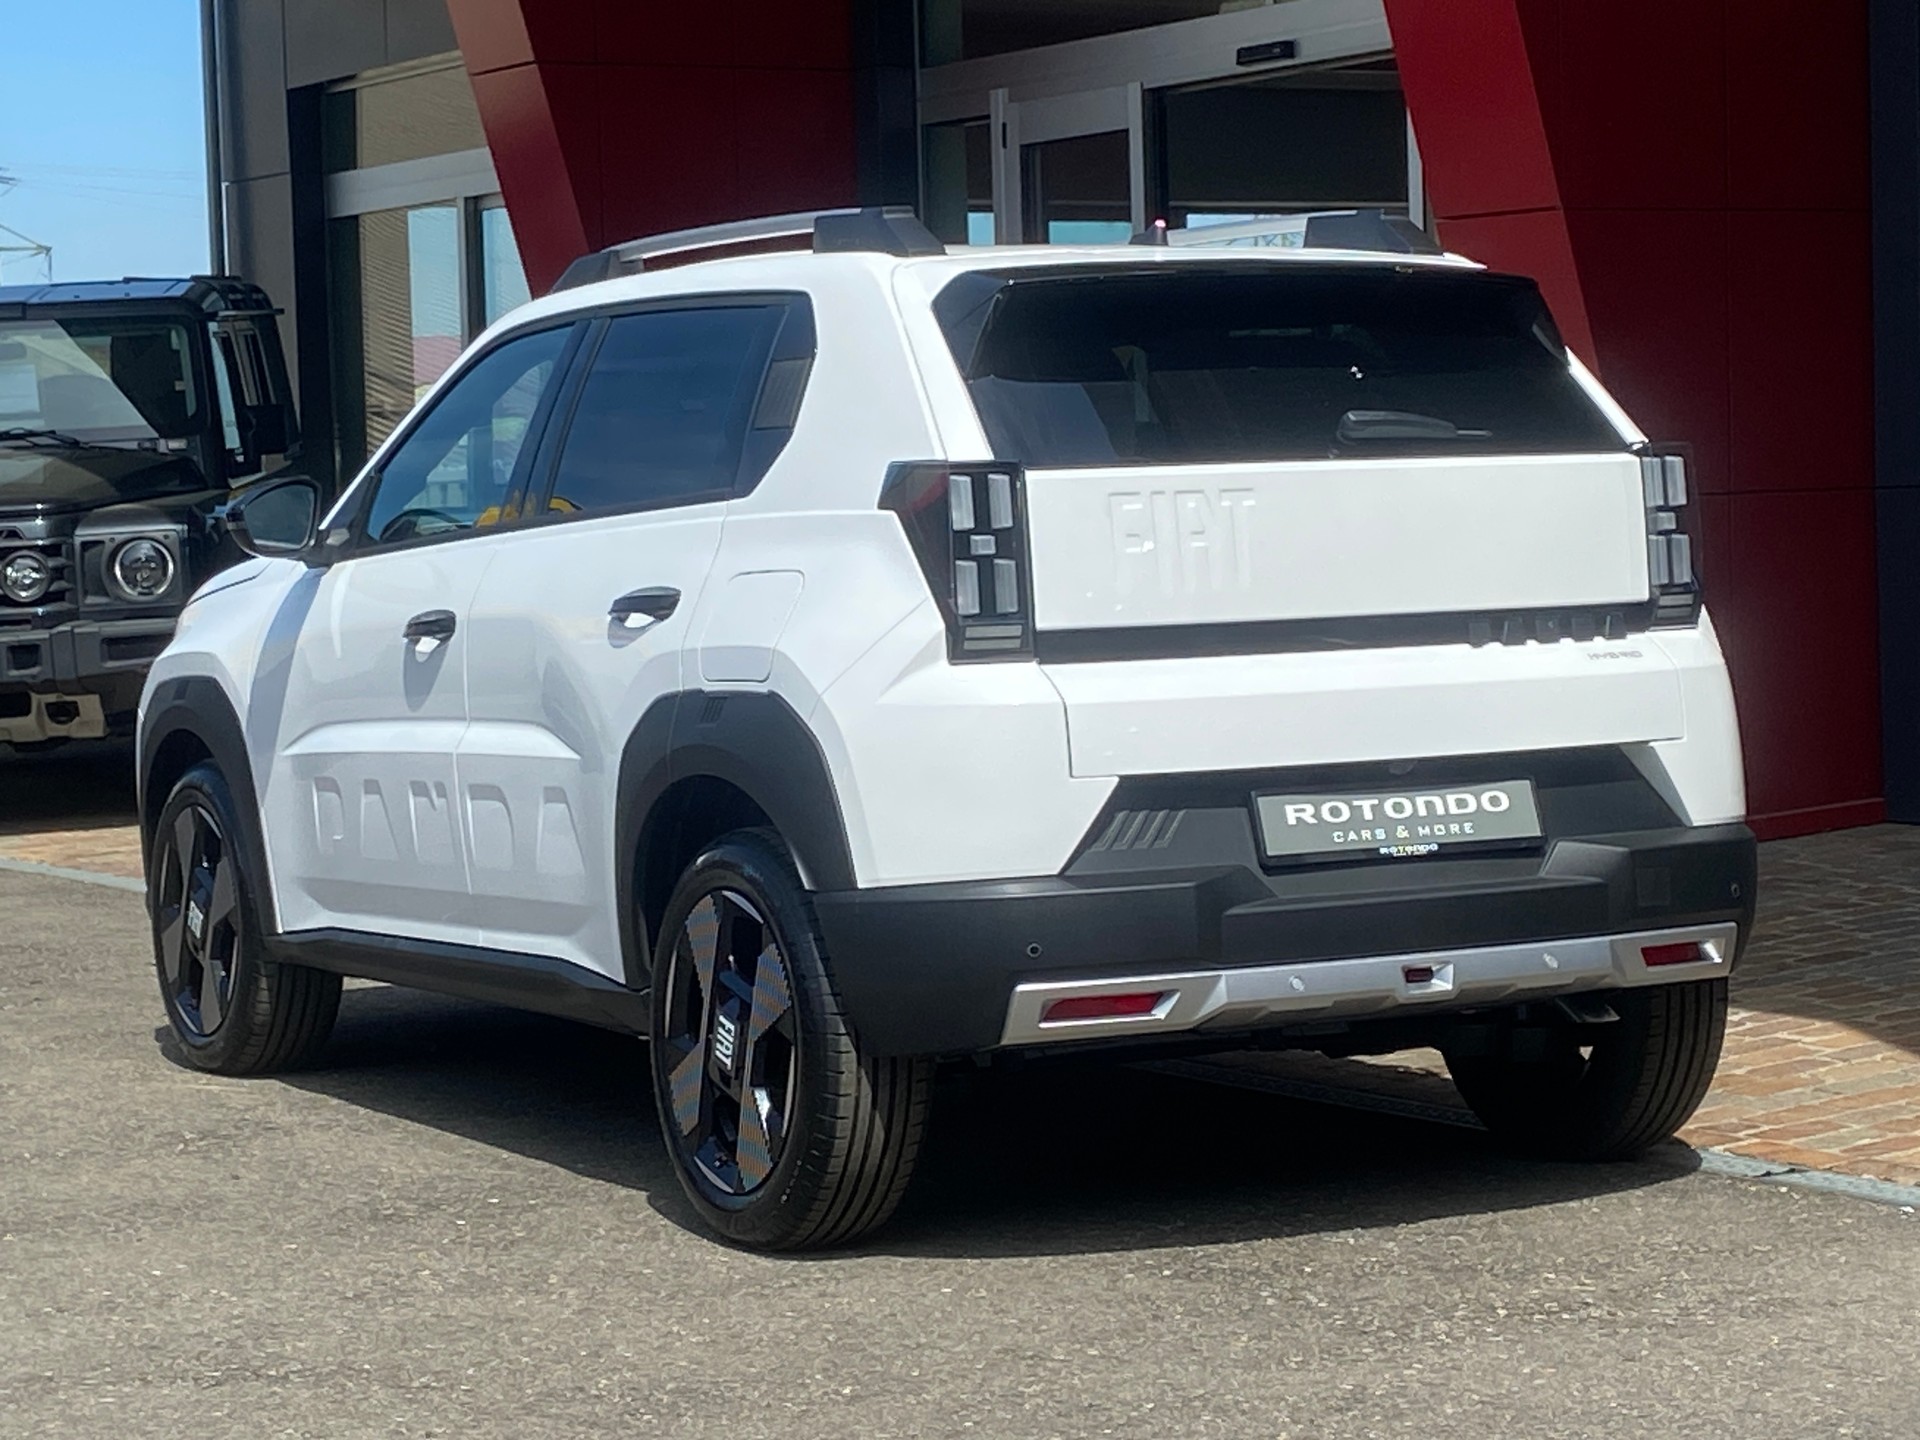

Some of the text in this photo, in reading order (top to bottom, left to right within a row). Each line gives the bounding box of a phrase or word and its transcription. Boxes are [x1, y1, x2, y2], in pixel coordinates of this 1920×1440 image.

[1107, 487, 1256, 599] FIAT
[311, 775, 588, 875] PANDA
[1284, 791, 1510, 825] ROTONDO
[1332, 822, 1475, 844] CARS & MORE
[714, 1013, 737, 1071] FIAT
